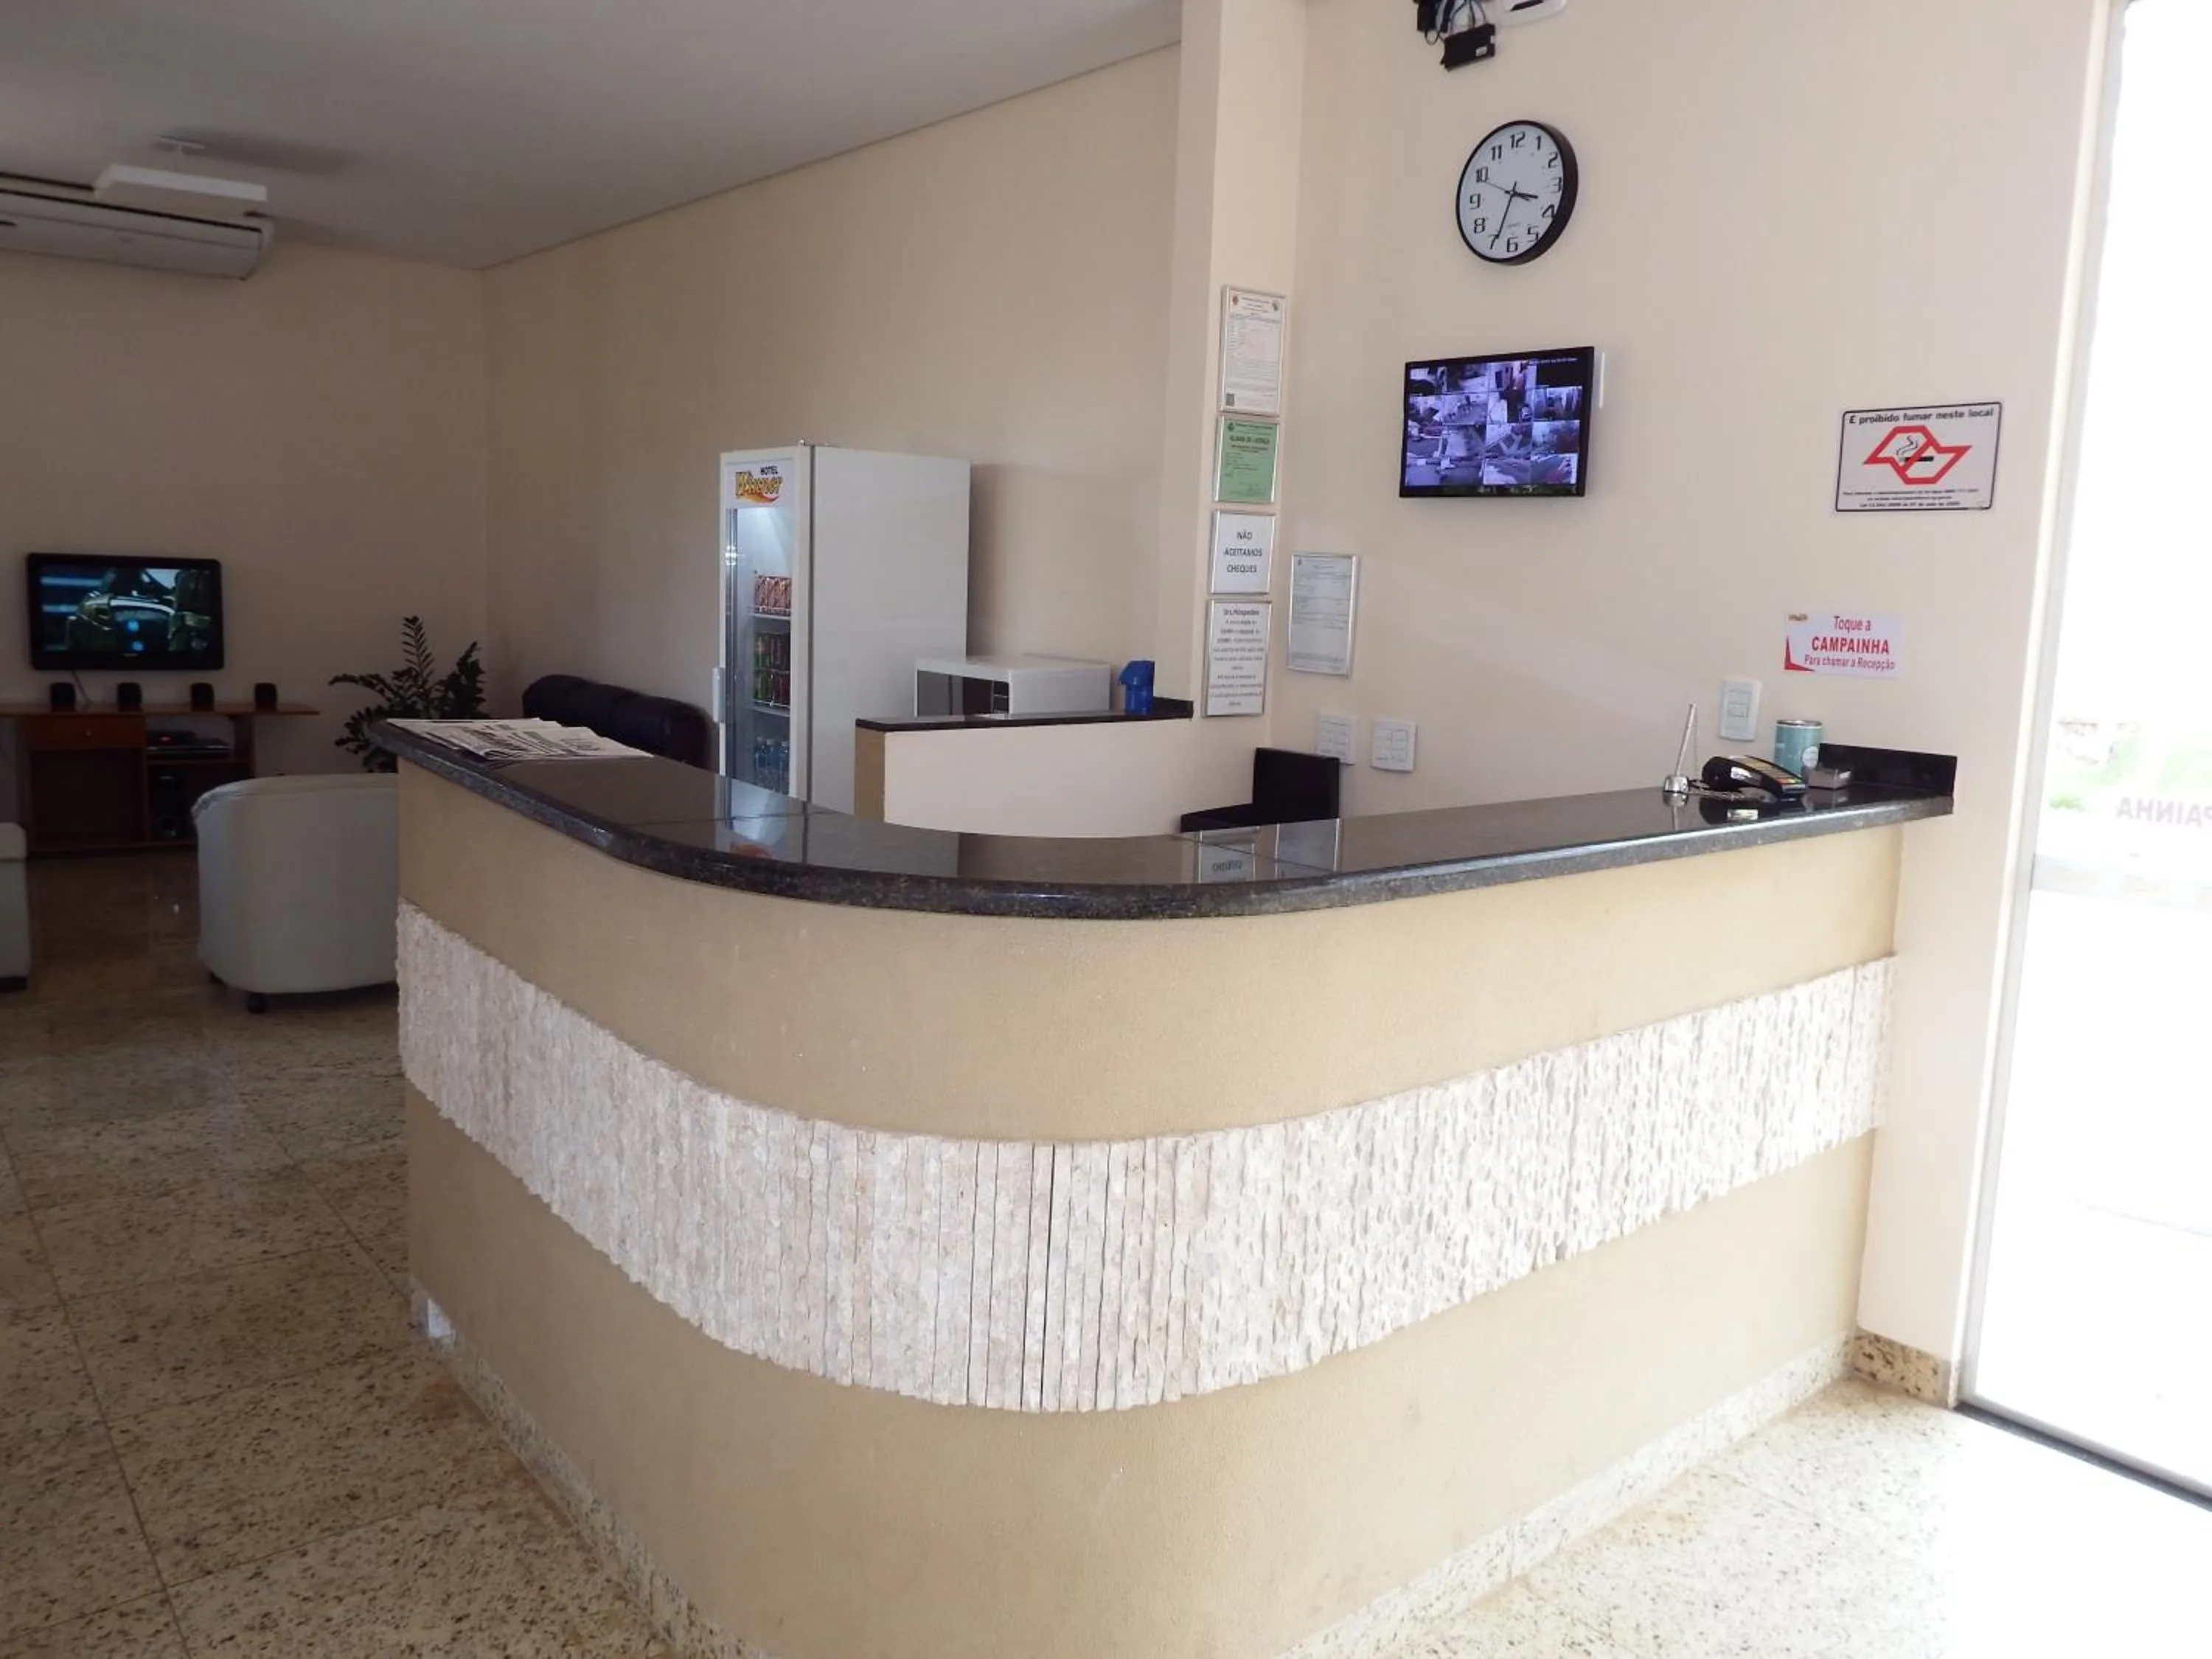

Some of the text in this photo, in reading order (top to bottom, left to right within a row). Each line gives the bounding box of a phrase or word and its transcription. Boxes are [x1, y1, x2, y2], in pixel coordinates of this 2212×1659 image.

[1510, 131, 1526, 149] 12
[1536, 135, 1542, 150] 1
[1490, 145, 1502, 161] 11
[1548, 152, 1558, 168] 2
[1476, 167, 1489, 183] 10
[1551, 177, 1562, 193] 3
[1470, 193, 1481, 209] 9
[1542, 204, 1556, 219] 4
[1474, 218, 1485, 234] 8
[1527, 224, 1540, 242] 5
[1488, 233, 1499, 250] 7
[1506, 237, 1518, 252] 6
[1859, 414, 1900, 425] proibido
[1903, 412, 1933, 421] fumar
[1935, 410, 1965, 420] neste
[1968, 408, 1994, 417] local
[1237, 529, 1253, 540] NÃO
[1224, 548, 1263, 557] ACEITAMOS
[1226, 564, 1257, 573] CHEQUES
[1834, 616, 1871, 633] Toque a
[1812, 636, 1890, 655] CAMPAINHA
[1804, 654, 1820, 666] Para
[1822, 655, 1849, 667] chamar
[1857, 656, 1895, 671] Recepção
